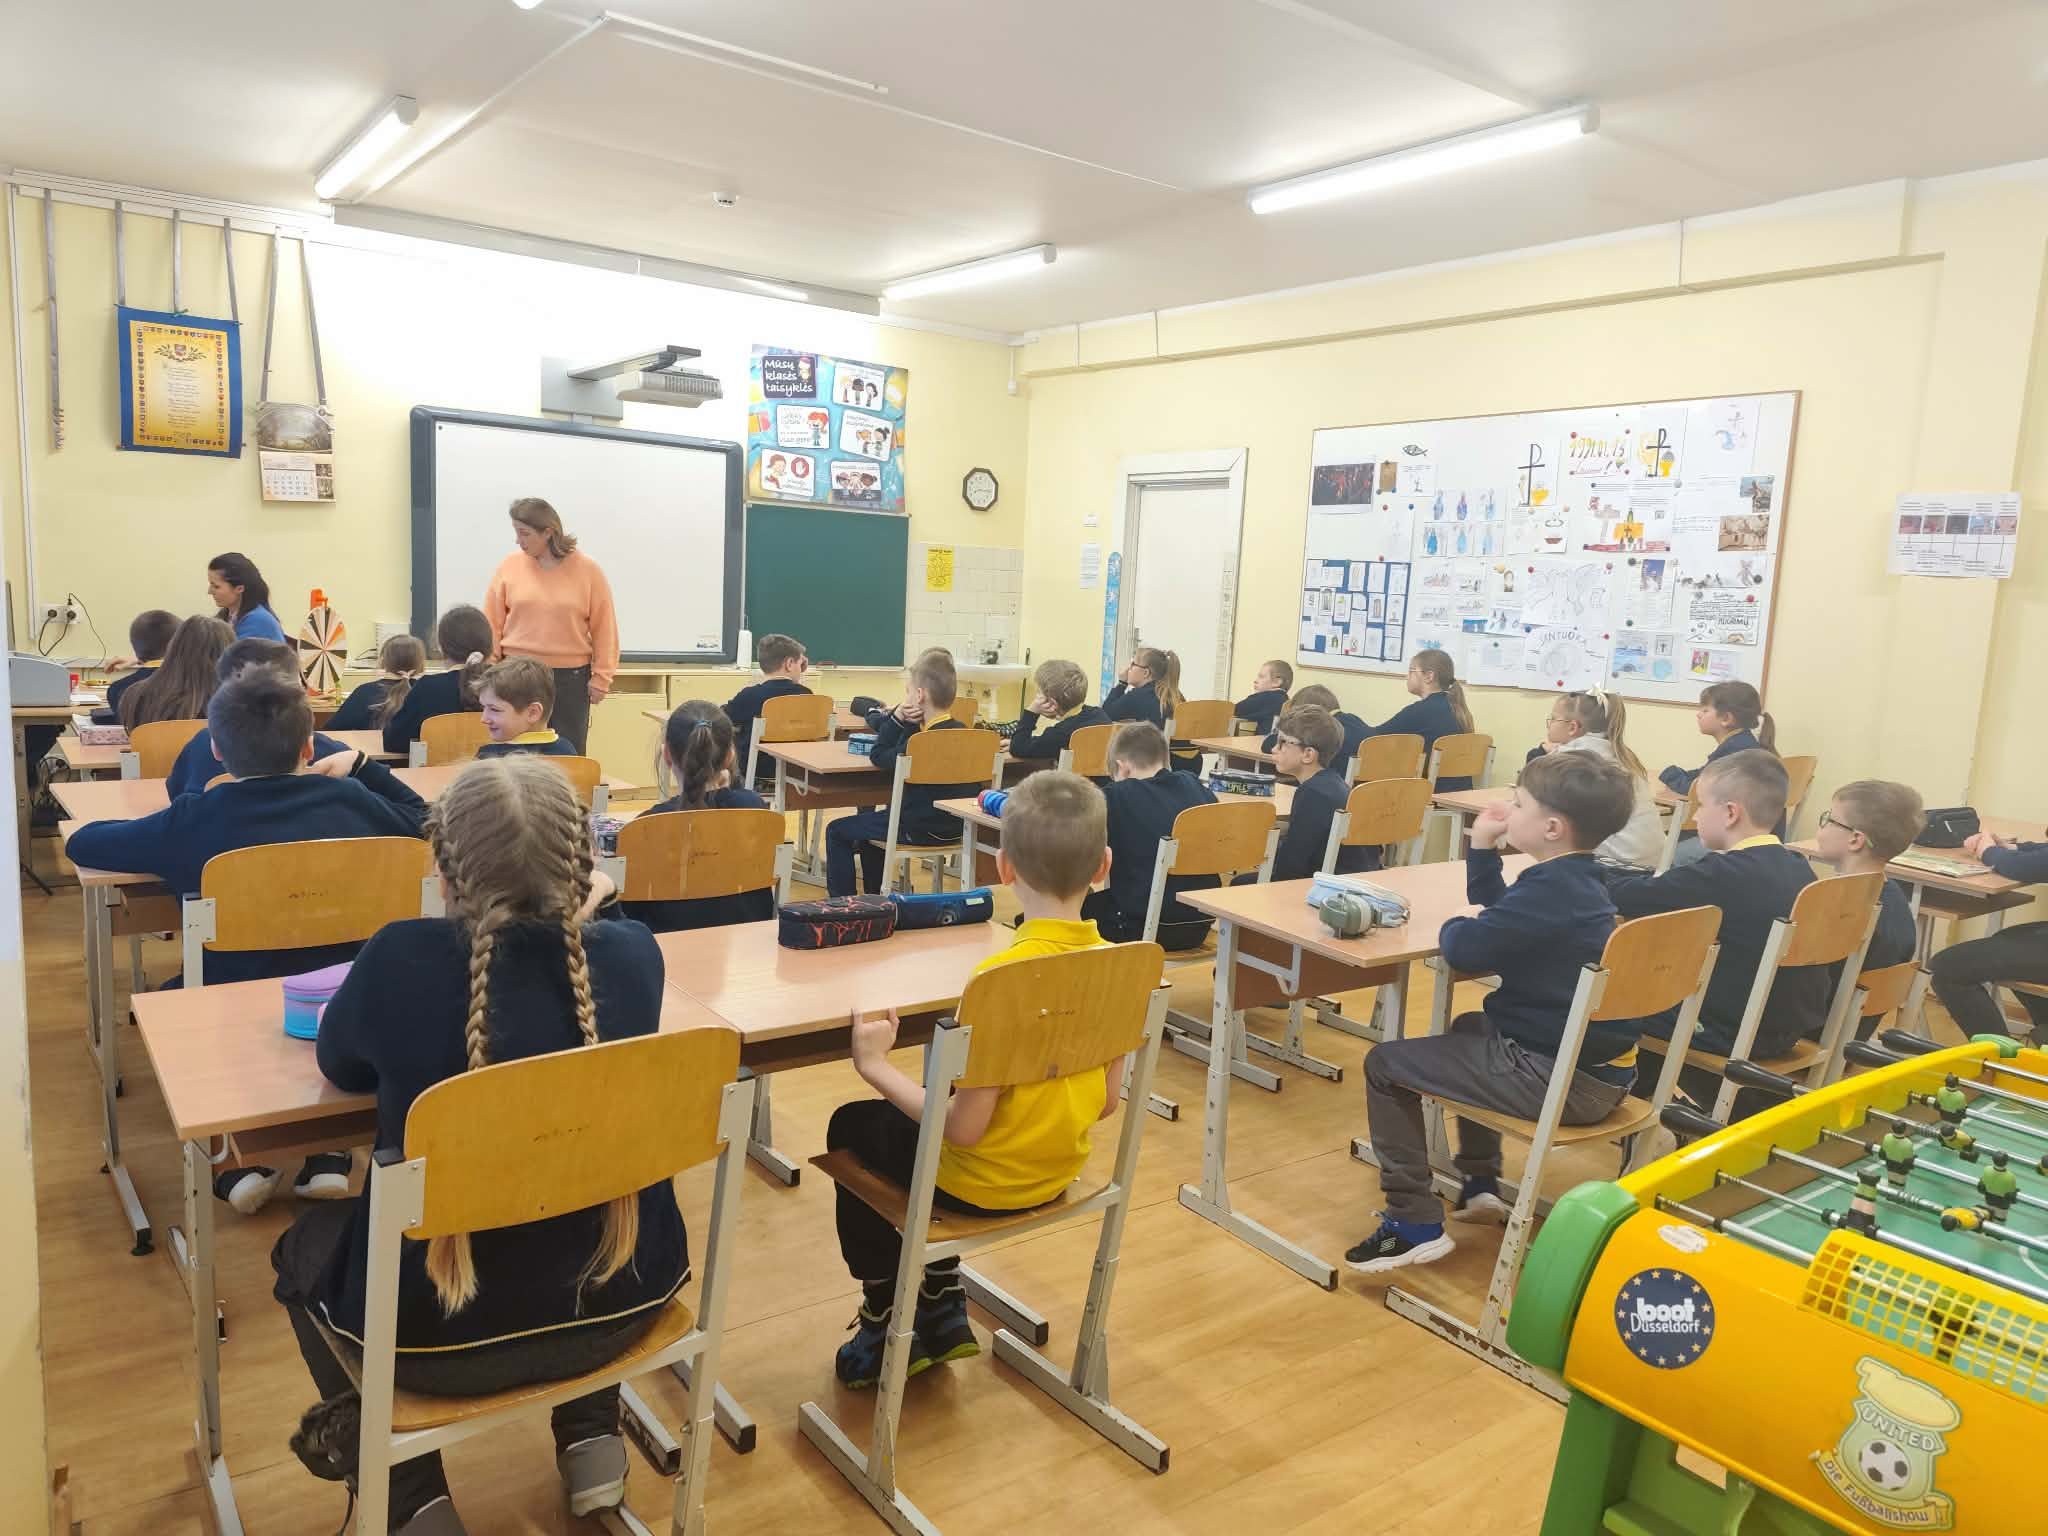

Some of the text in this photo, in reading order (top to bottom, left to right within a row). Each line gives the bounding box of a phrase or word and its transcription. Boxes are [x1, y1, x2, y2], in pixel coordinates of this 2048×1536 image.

[764, 359, 795, 370] Mūsų
[765, 370, 797, 380] klasės
[766, 382, 813, 397] taisyklės
[1637, 1297, 1695, 1322] boot
[1630, 1312, 1700, 1333] Düsseldorf
[1861, 1406, 1936, 1453] UNITED
[1824, 1460, 1842, 1481] Die
